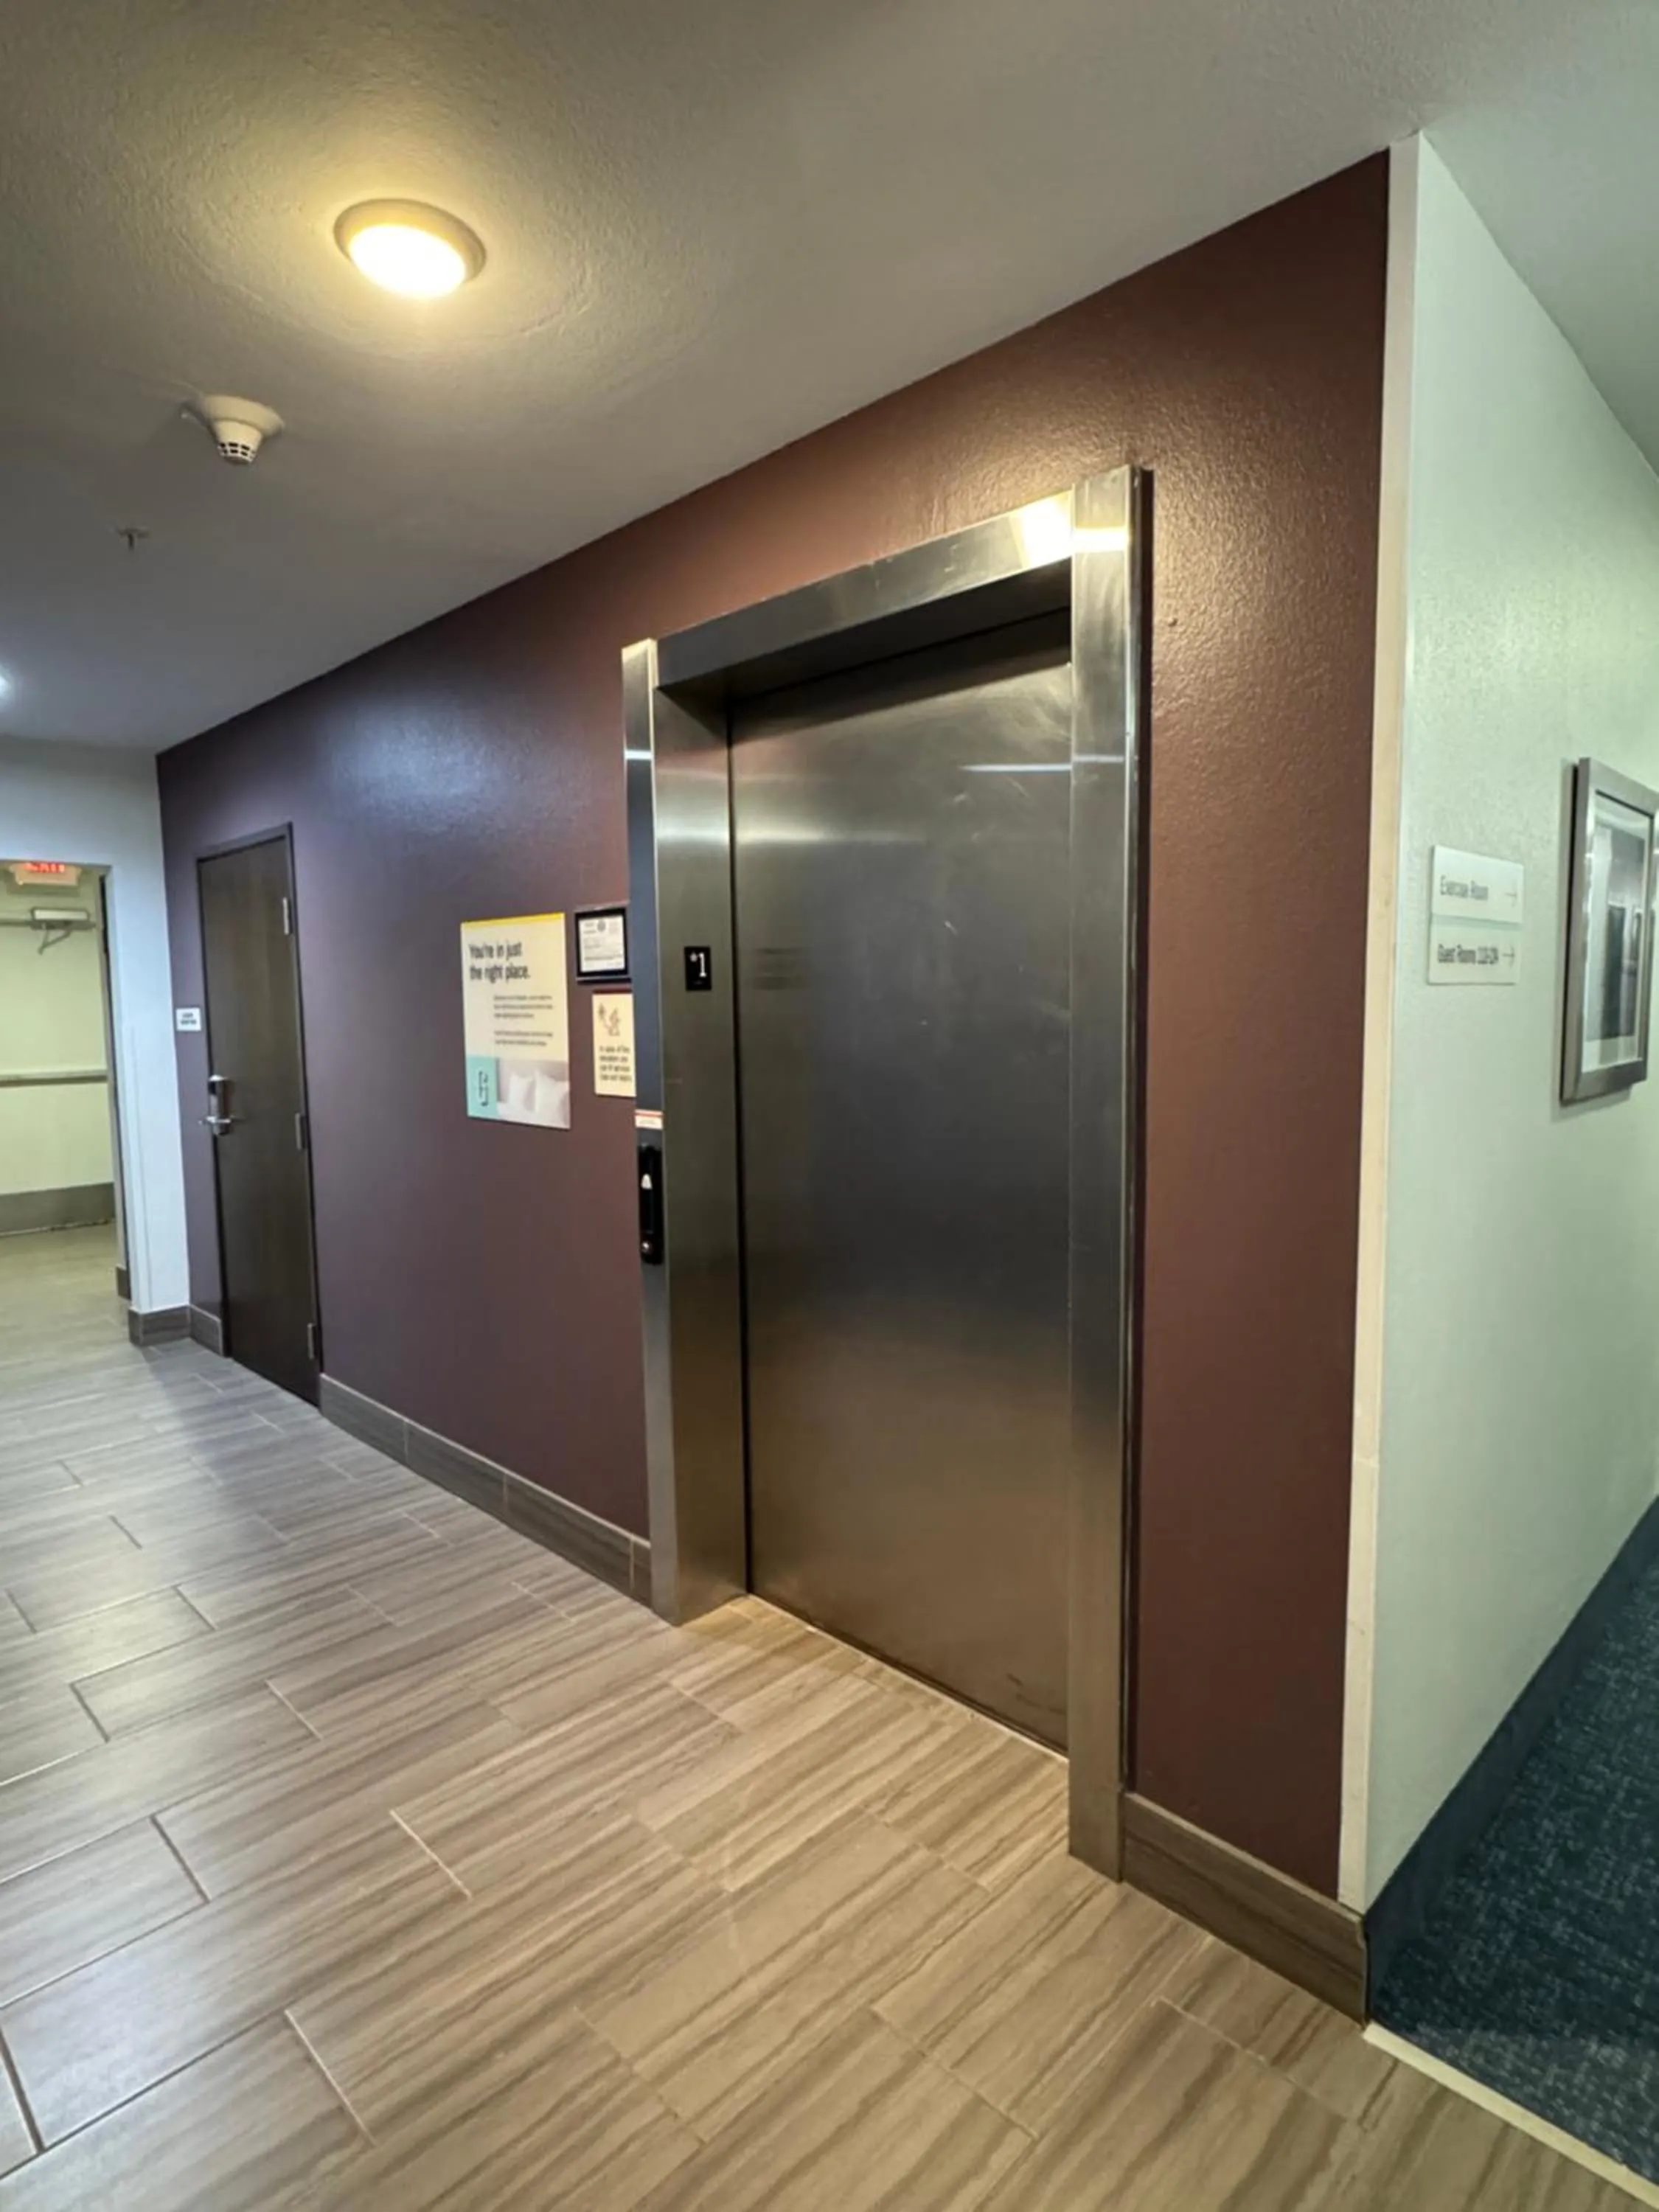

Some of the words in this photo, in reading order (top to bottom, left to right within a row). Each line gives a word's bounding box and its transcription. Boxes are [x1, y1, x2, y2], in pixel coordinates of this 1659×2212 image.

[469, 942, 494, 959] You're
[496, 940, 504, 958] in
[506, 939, 523, 961] just
[470, 964, 482, 981] the
[484, 964, 503, 984] right
[505, 962, 531, 984] place.
